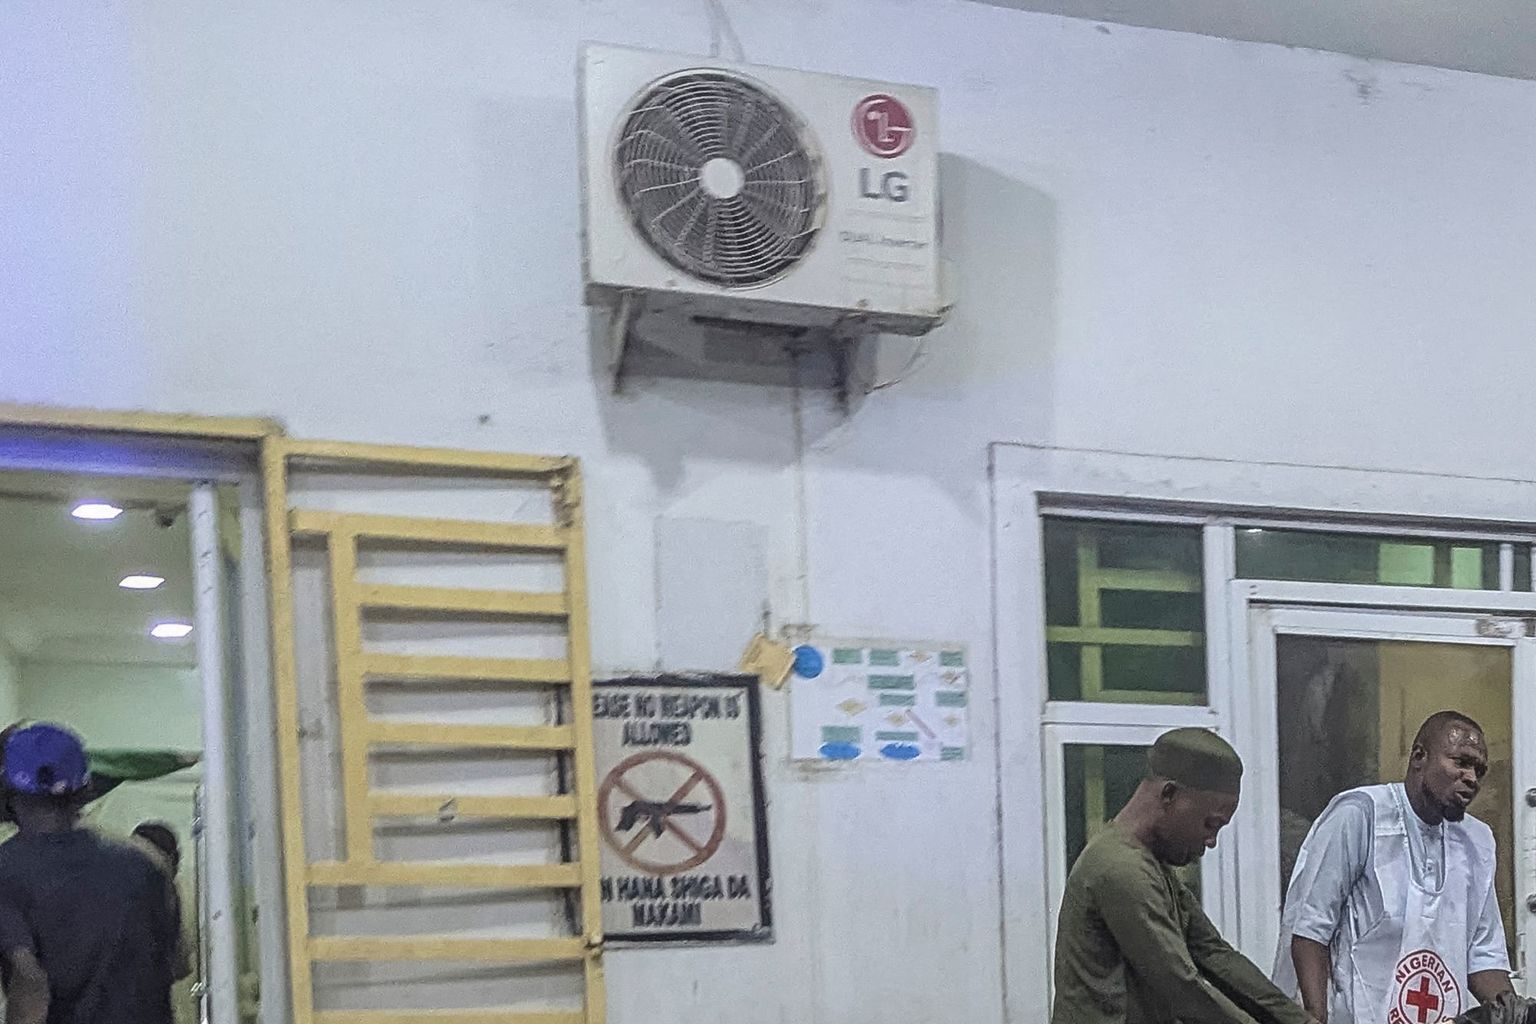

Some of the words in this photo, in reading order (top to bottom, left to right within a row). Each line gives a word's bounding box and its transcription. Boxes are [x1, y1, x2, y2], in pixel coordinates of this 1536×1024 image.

[861, 167, 909, 202] LG
[593, 693, 631, 718] EASE
[634, 693, 656, 718] NO
[660, 694, 720, 719] WEAPON
[622, 721, 692, 747] ALLOWED
[1395, 955, 1454, 993] NIGERIAN
